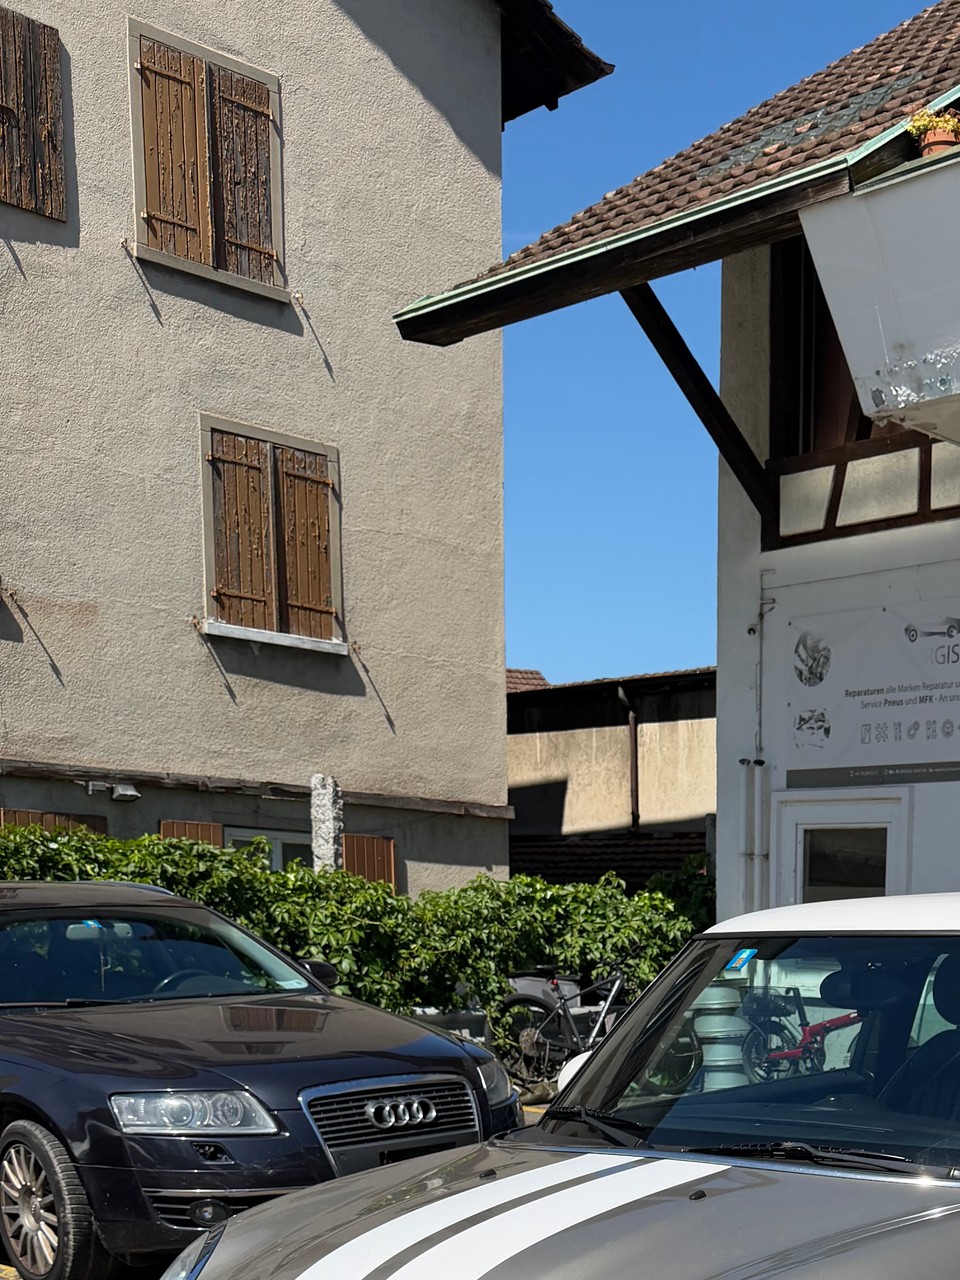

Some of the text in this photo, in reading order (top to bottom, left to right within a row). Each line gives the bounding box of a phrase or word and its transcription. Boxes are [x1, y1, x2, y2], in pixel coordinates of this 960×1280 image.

[845, 686, 885, 698] Reparaturen
[885, 685, 896, 695] alle
[898, 683, 921, 694] Marken
[922, 681, 954, 692] Reparatur
[861, 700, 883, 709] Service
[884, 698, 904, 708] Pneus
[905, 696, 917, 705] und
[918, 695, 934, 704] MFK
[939, 694, 949, 703] An
